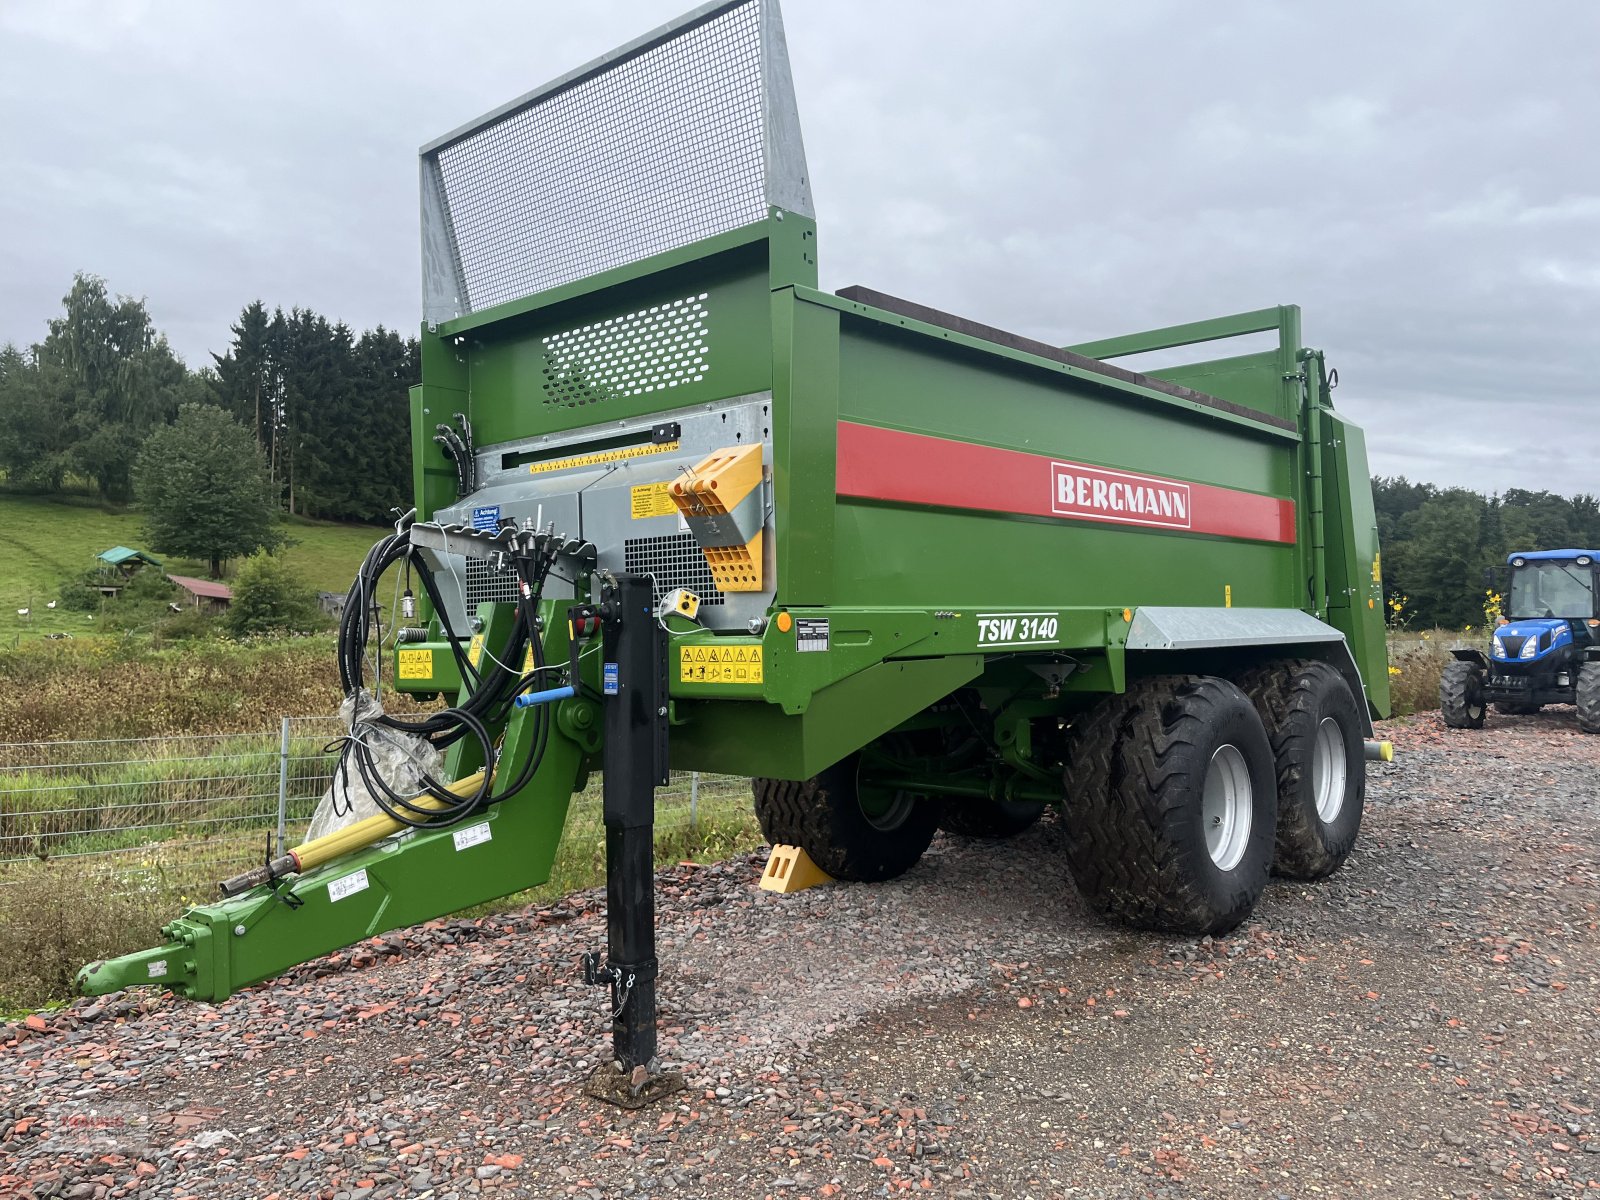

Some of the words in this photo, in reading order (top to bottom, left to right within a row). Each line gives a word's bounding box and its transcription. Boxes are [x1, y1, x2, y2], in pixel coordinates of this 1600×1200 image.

[1057, 473, 1186, 519] BERGMANN
[978, 619, 1017, 642] TSW
[1018, 617, 1058, 640] 3140
